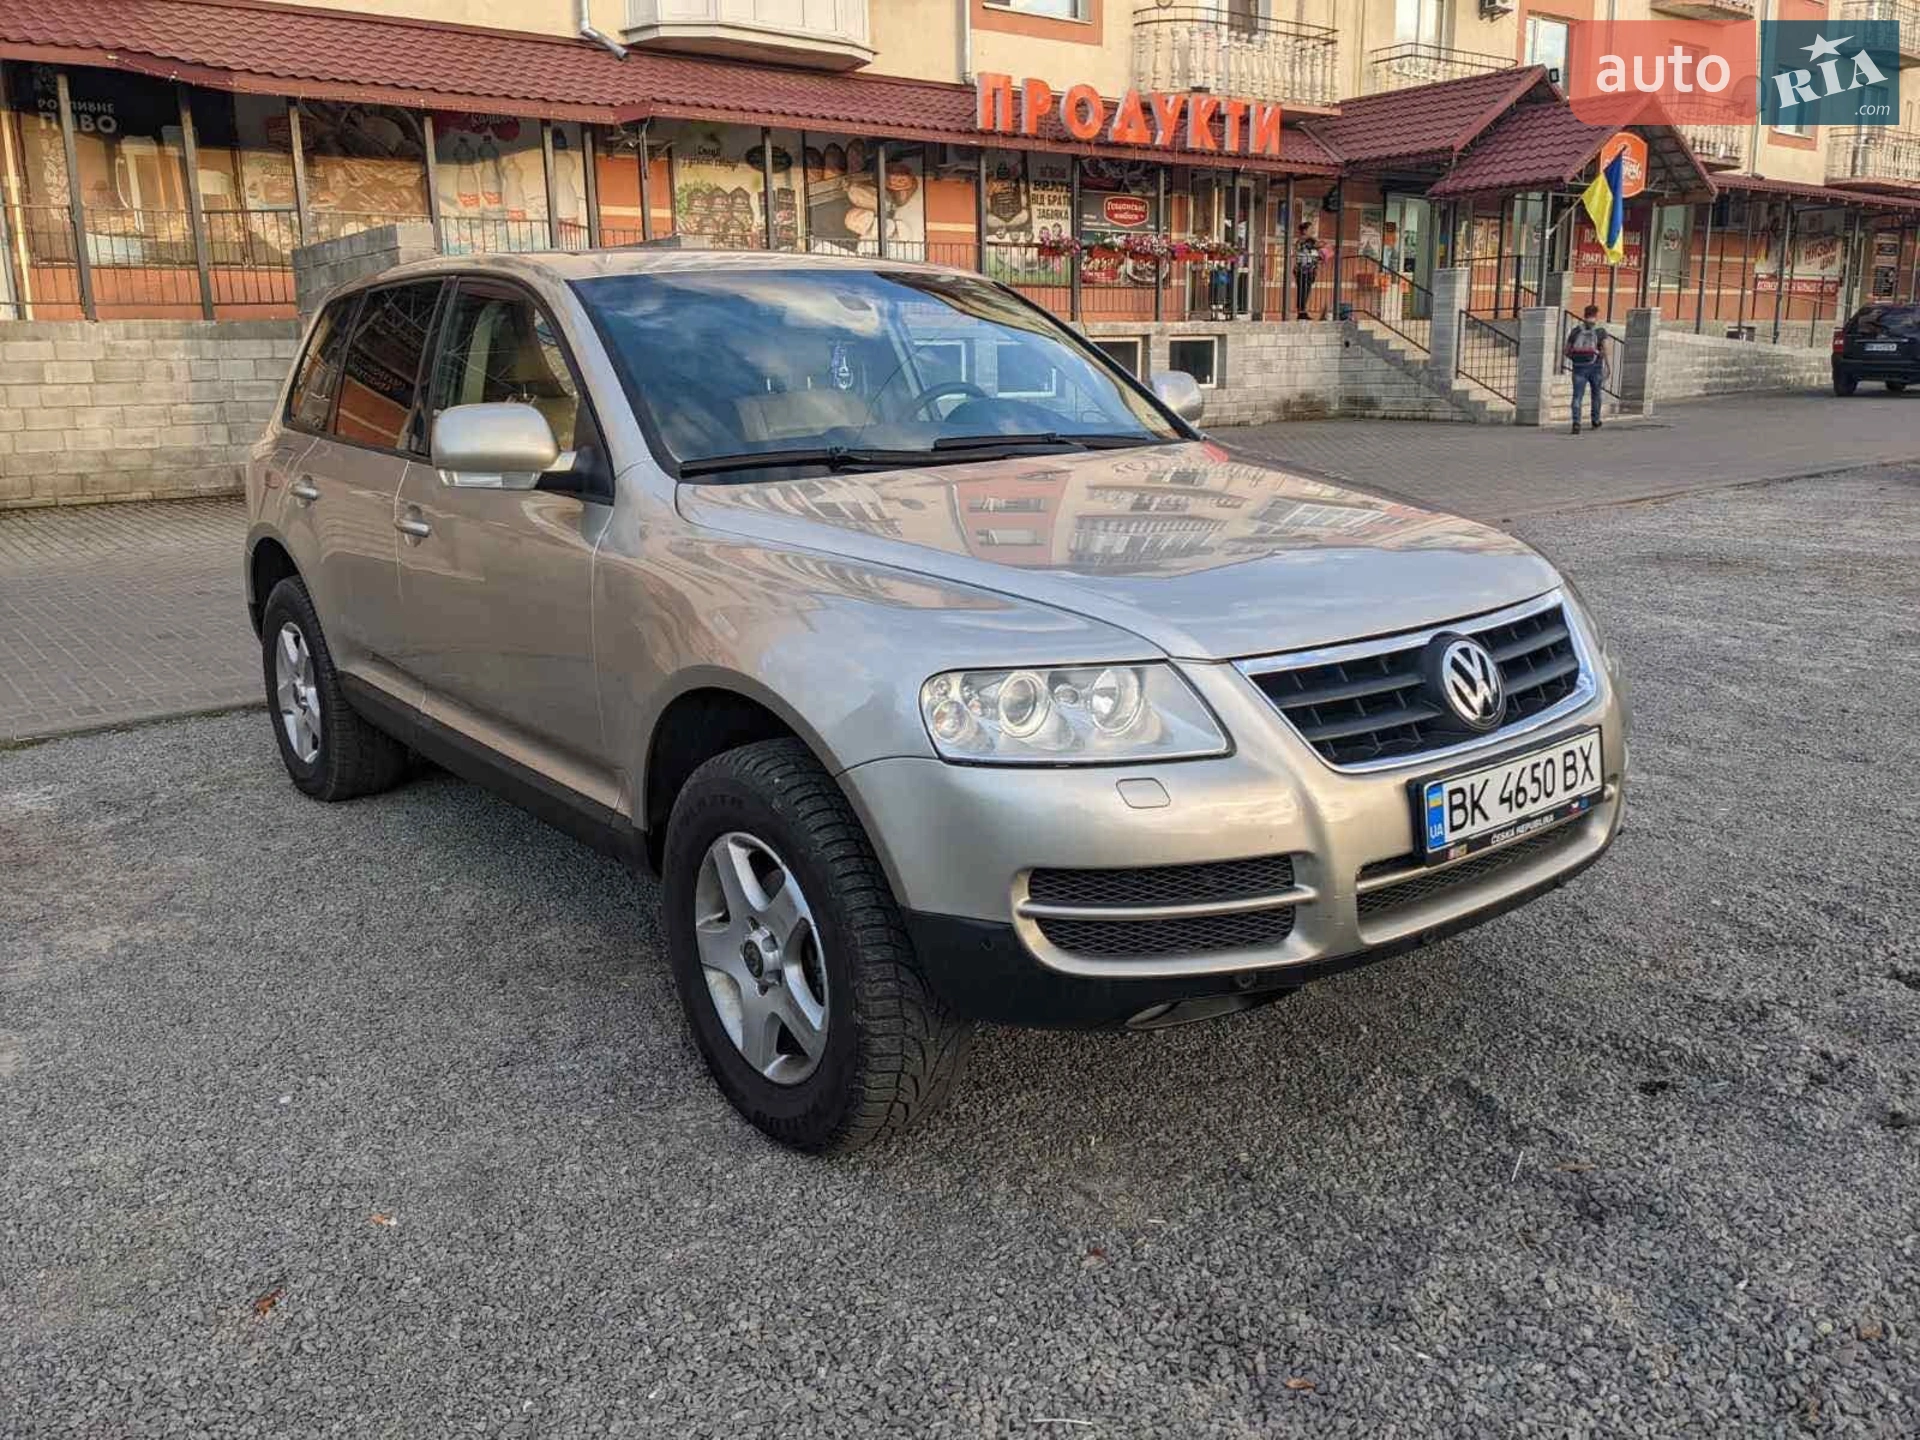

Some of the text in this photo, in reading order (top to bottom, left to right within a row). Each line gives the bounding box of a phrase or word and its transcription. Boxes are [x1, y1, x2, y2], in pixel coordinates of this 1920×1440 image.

[38, 99, 115, 113] РОЛИВНЕ
[976, 71, 1282, 155] ПРОДУКТИ
[1448, 741, 1595, 833] BK 4650 BX
[1430, 825, 1445, 839] UA
